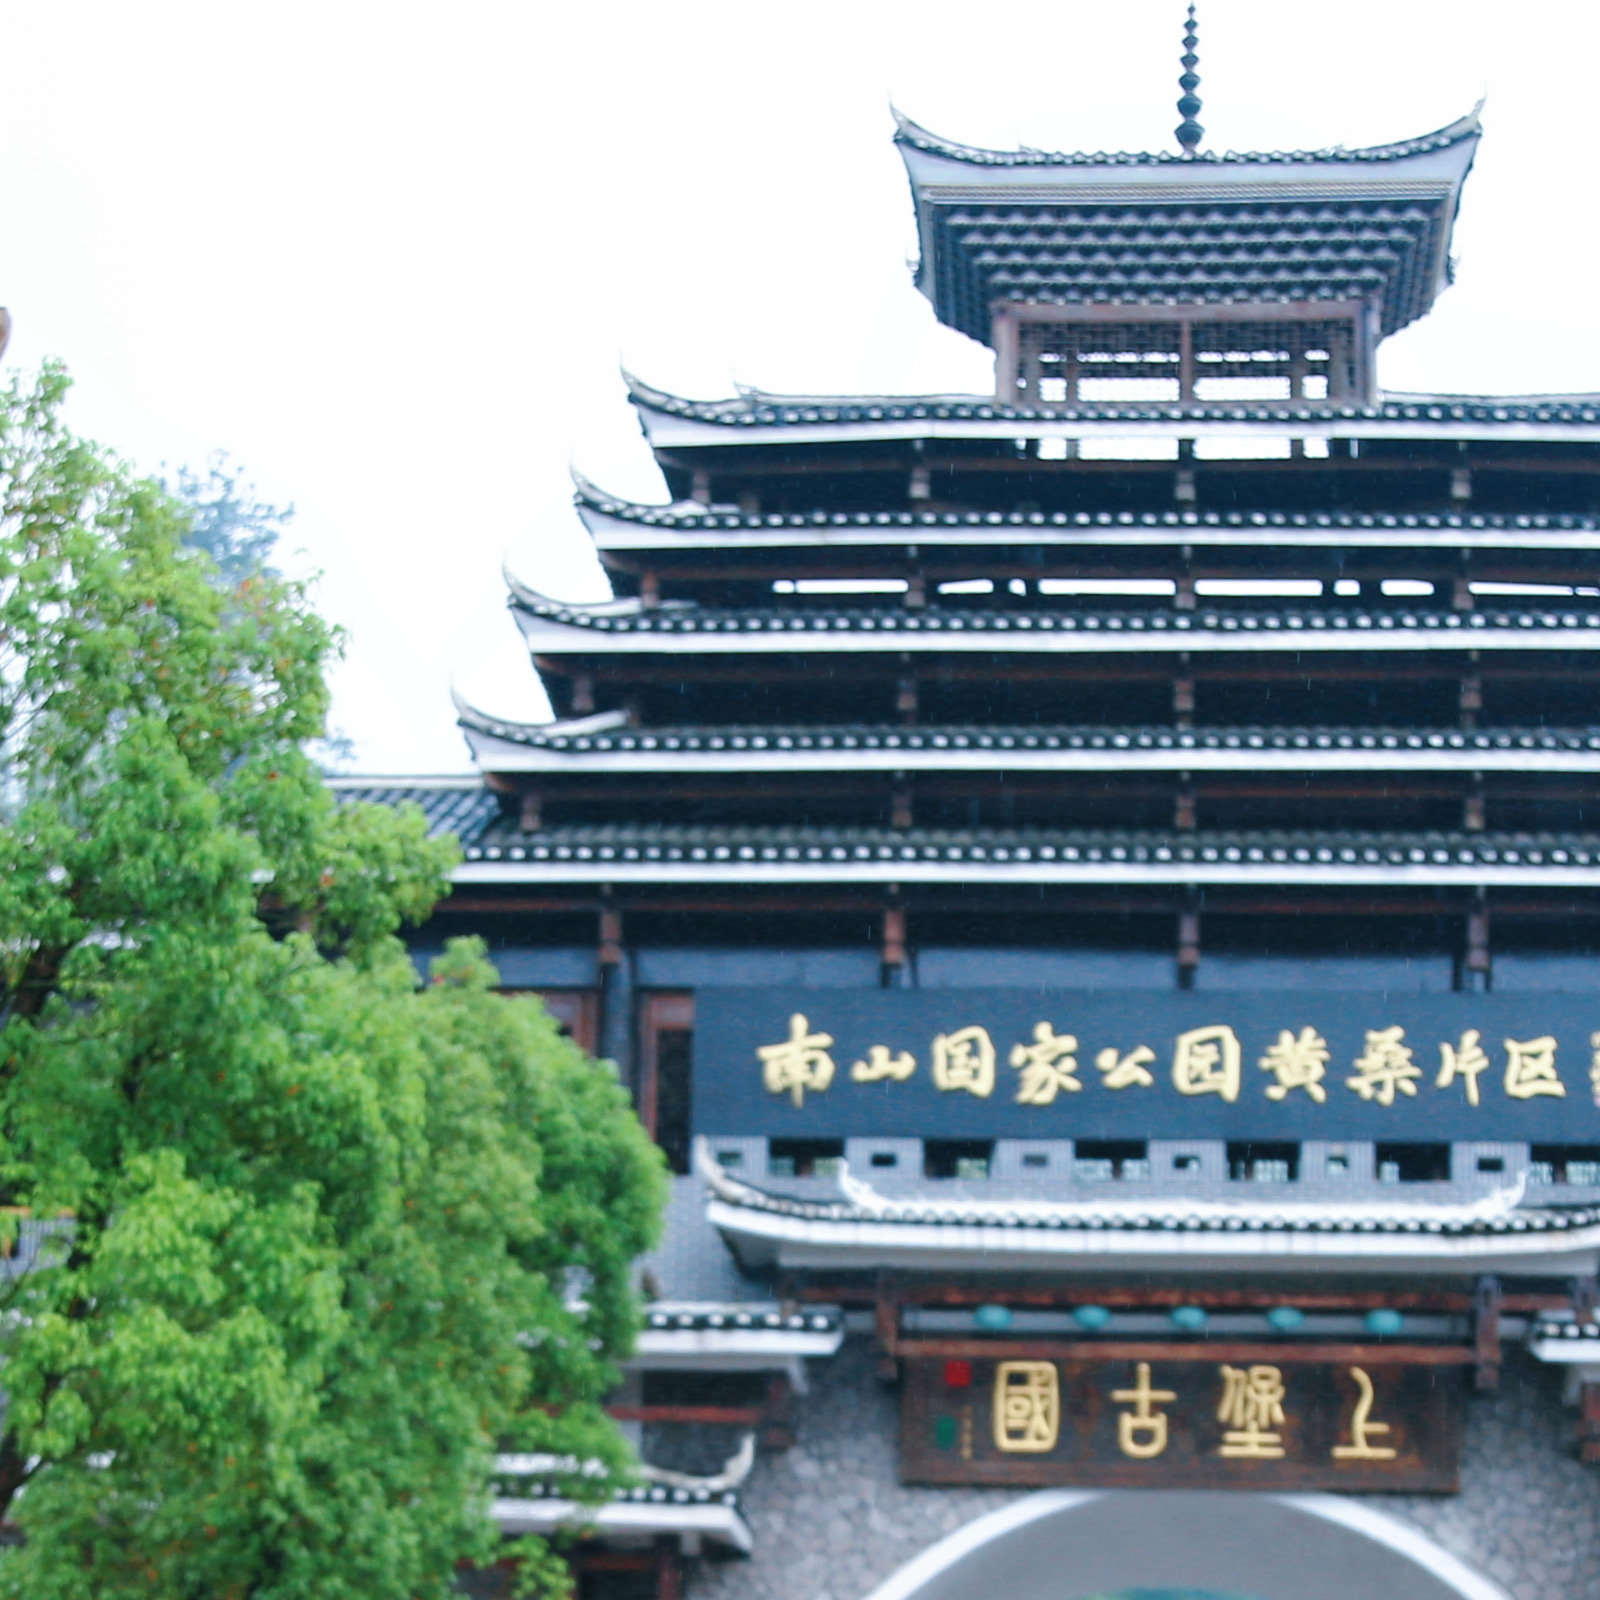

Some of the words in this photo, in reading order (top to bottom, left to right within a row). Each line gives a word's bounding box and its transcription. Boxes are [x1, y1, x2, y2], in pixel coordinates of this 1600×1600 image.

[755, 1012, 1567, 1109] 南山国家公园黄桑片区
